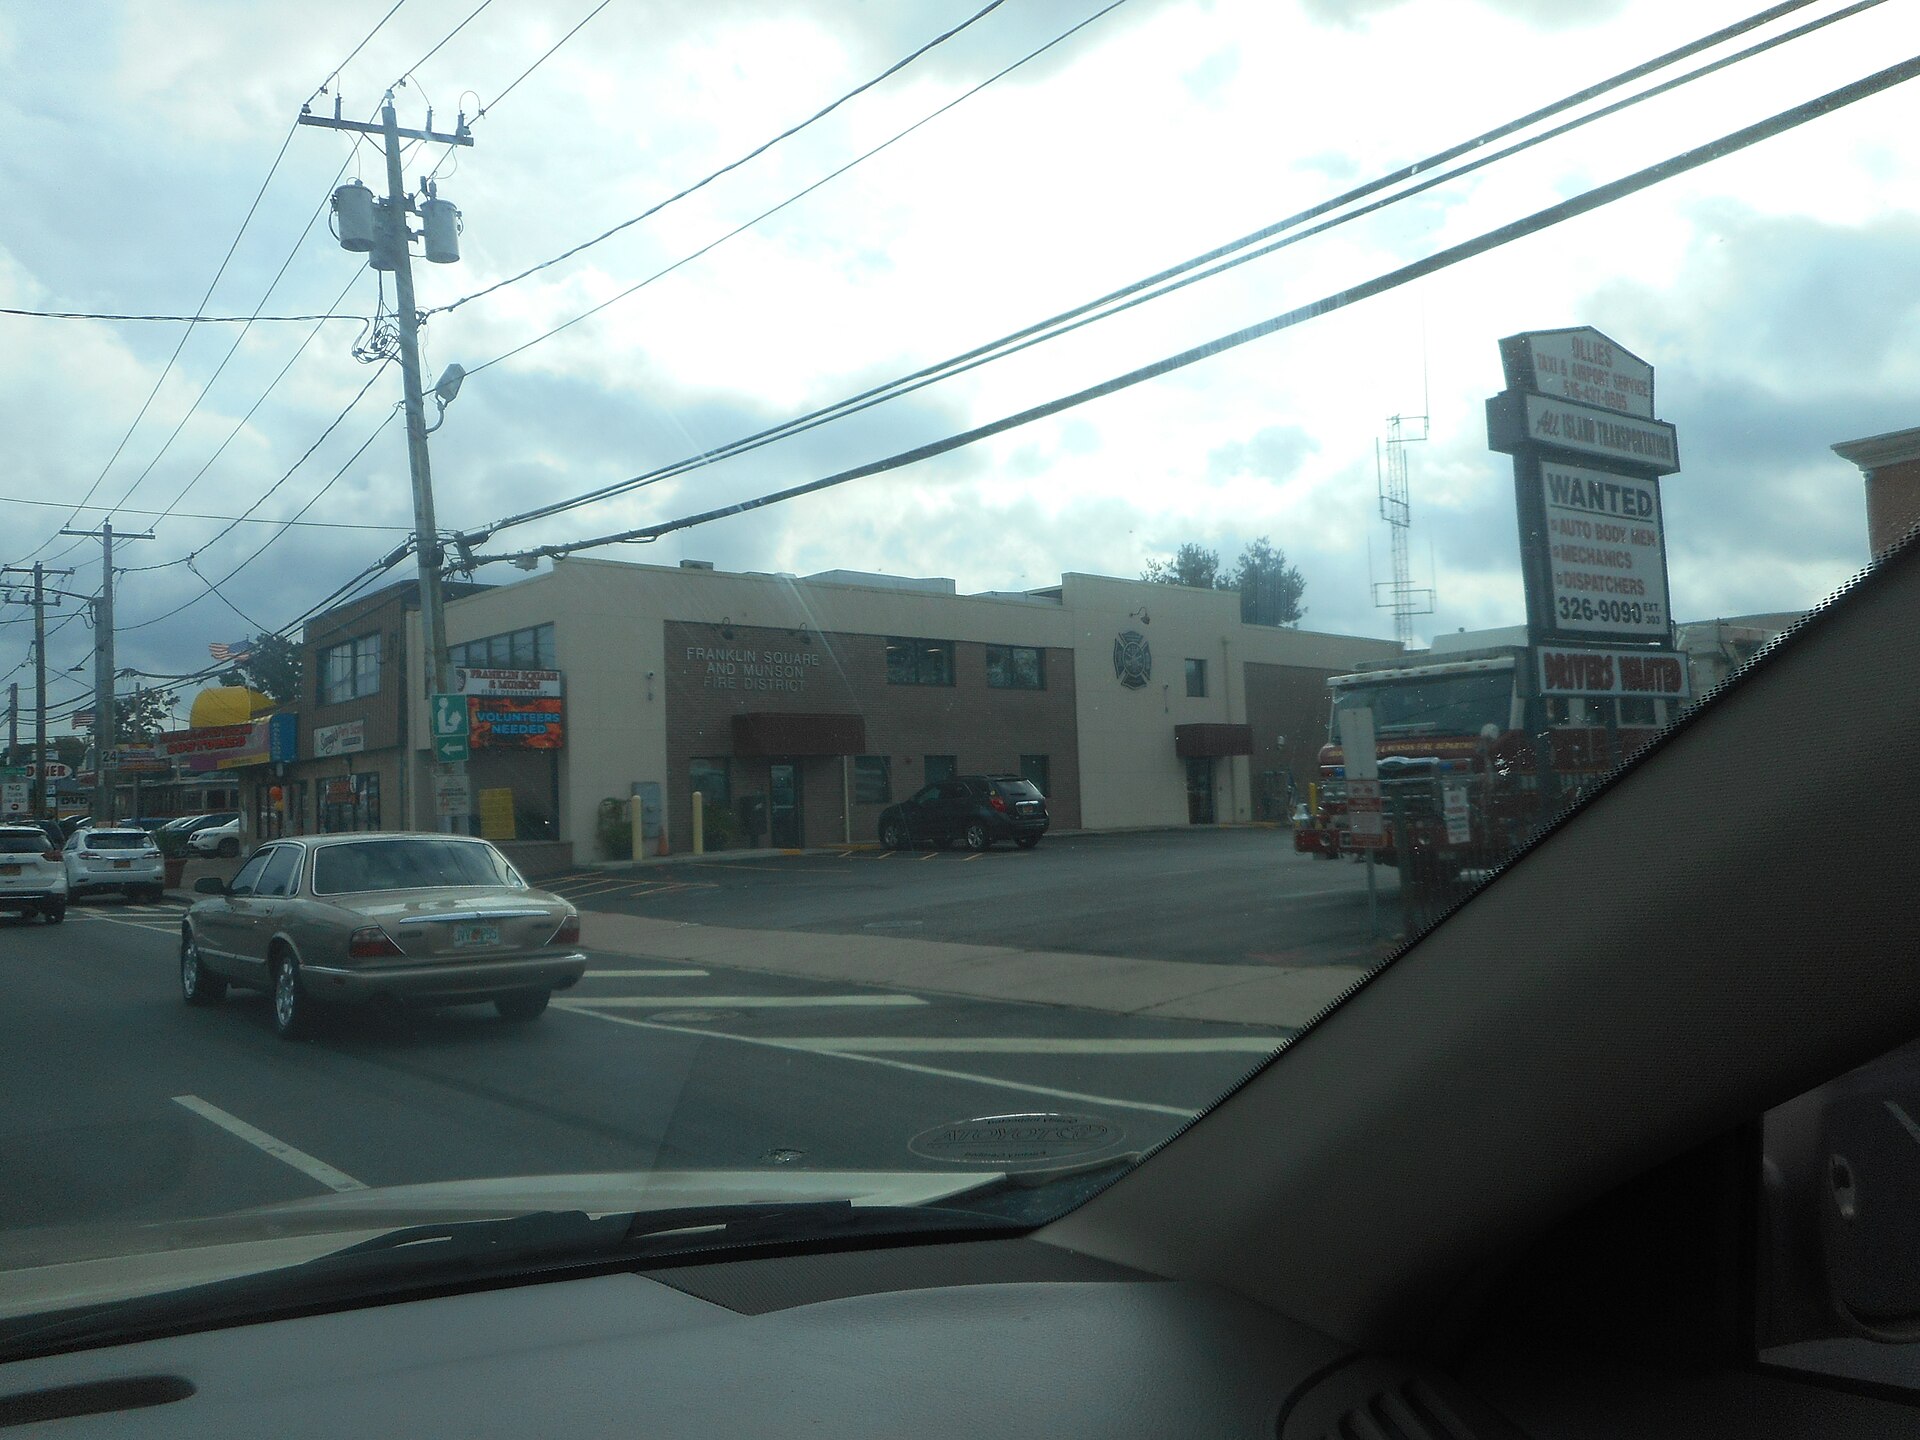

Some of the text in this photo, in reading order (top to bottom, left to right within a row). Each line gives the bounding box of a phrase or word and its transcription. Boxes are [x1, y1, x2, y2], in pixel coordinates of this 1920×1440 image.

[1547, 472, 1653, 518] WANTED
[1560, 518, 1656, 547] AUTO BODY MEN
[1560, 543, 1632, 569] MECHANICS
[1563, 571, 1645, 596] DISPATCHERS
[1558, 596, 1642, 625] 326-9090
[687, 646, 820, 667] FRANKLIN SQUARE
[470, 669, 558, 681] FRANKLIN SQUARE
[706, 662, 804, 677] AND MUNSON
[1617, 655, 1683, 693] WANTED
[499, 680, 540, 690] MUNSON
[703, 676, 806, 692] FIRE DISTRICT
[477, 711, 560, 723] VOLUNTEERS
[492, 724, 547, 734] NEEDED
[26, 765, 66, 777] DER
